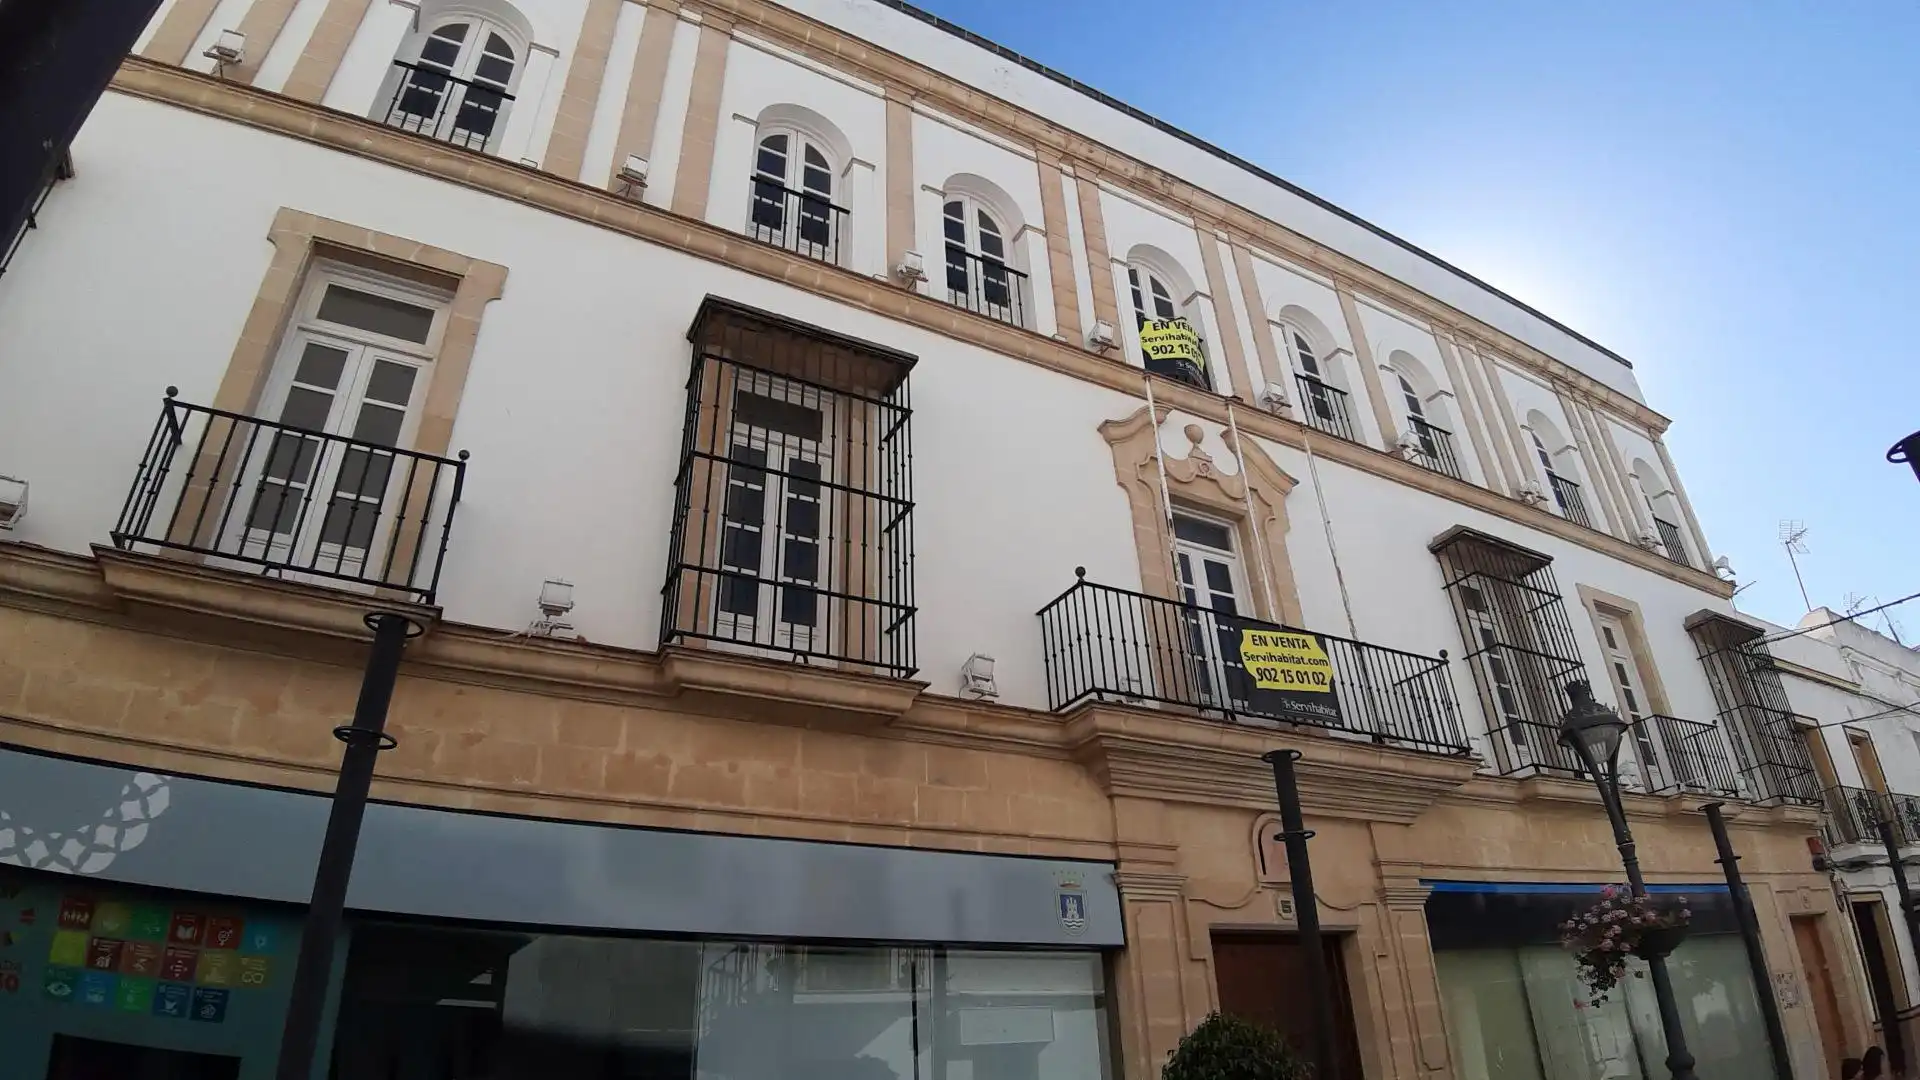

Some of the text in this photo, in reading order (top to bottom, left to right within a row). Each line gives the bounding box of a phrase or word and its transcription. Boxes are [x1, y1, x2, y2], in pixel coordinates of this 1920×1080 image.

[1152, 321, 1170, 331] EN
[1151, 344, 1176, 355] 902
[1177, 343, 1191, 355] 15
[1251, 634, 1311, 650] EN VENTA
[1243, 651, 1329, 667] Servihabitat.com
[1255, 667, 1328, 686] 902 15 01 02
